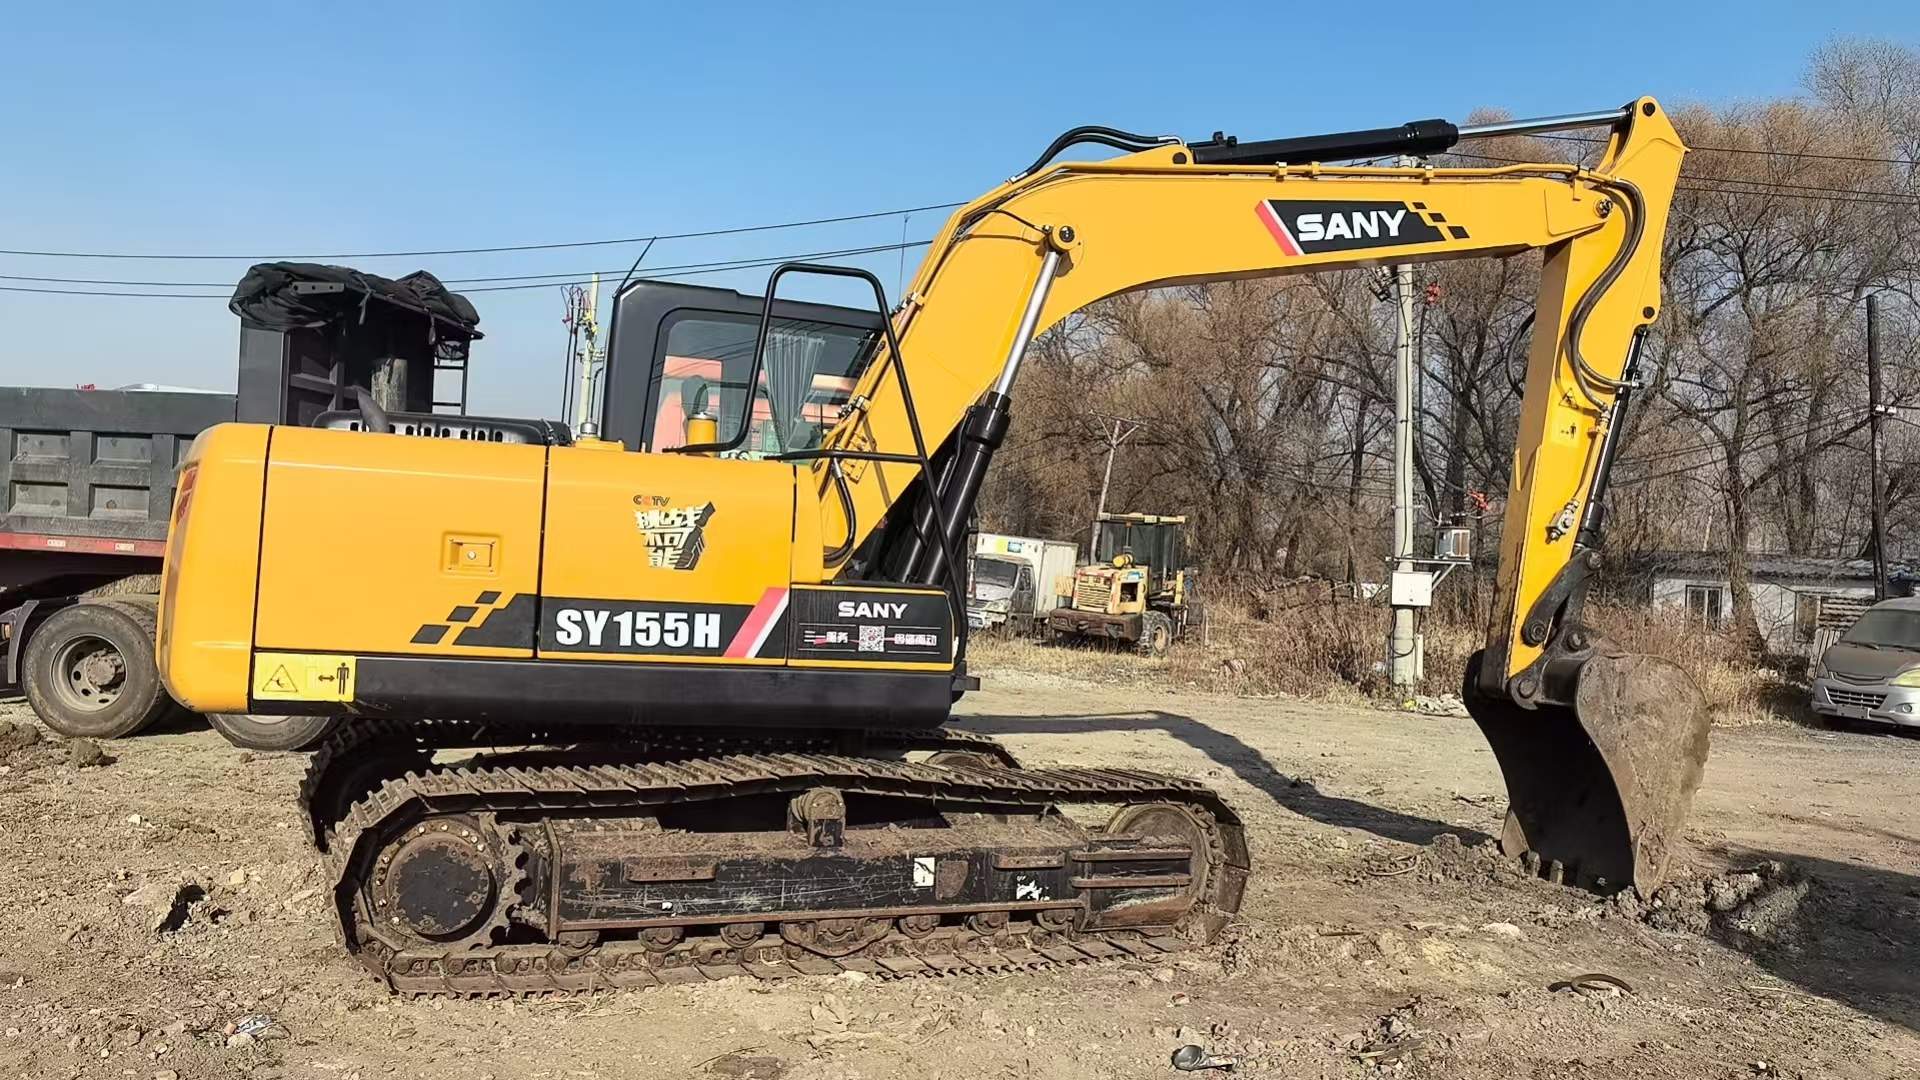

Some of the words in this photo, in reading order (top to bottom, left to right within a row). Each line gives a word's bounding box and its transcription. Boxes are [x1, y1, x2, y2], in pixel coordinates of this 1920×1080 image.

[1296, 209, 1407, 242] SANY
[838, 601, 908, 619] SANY
[555, 608, 721, 648] SY155H
